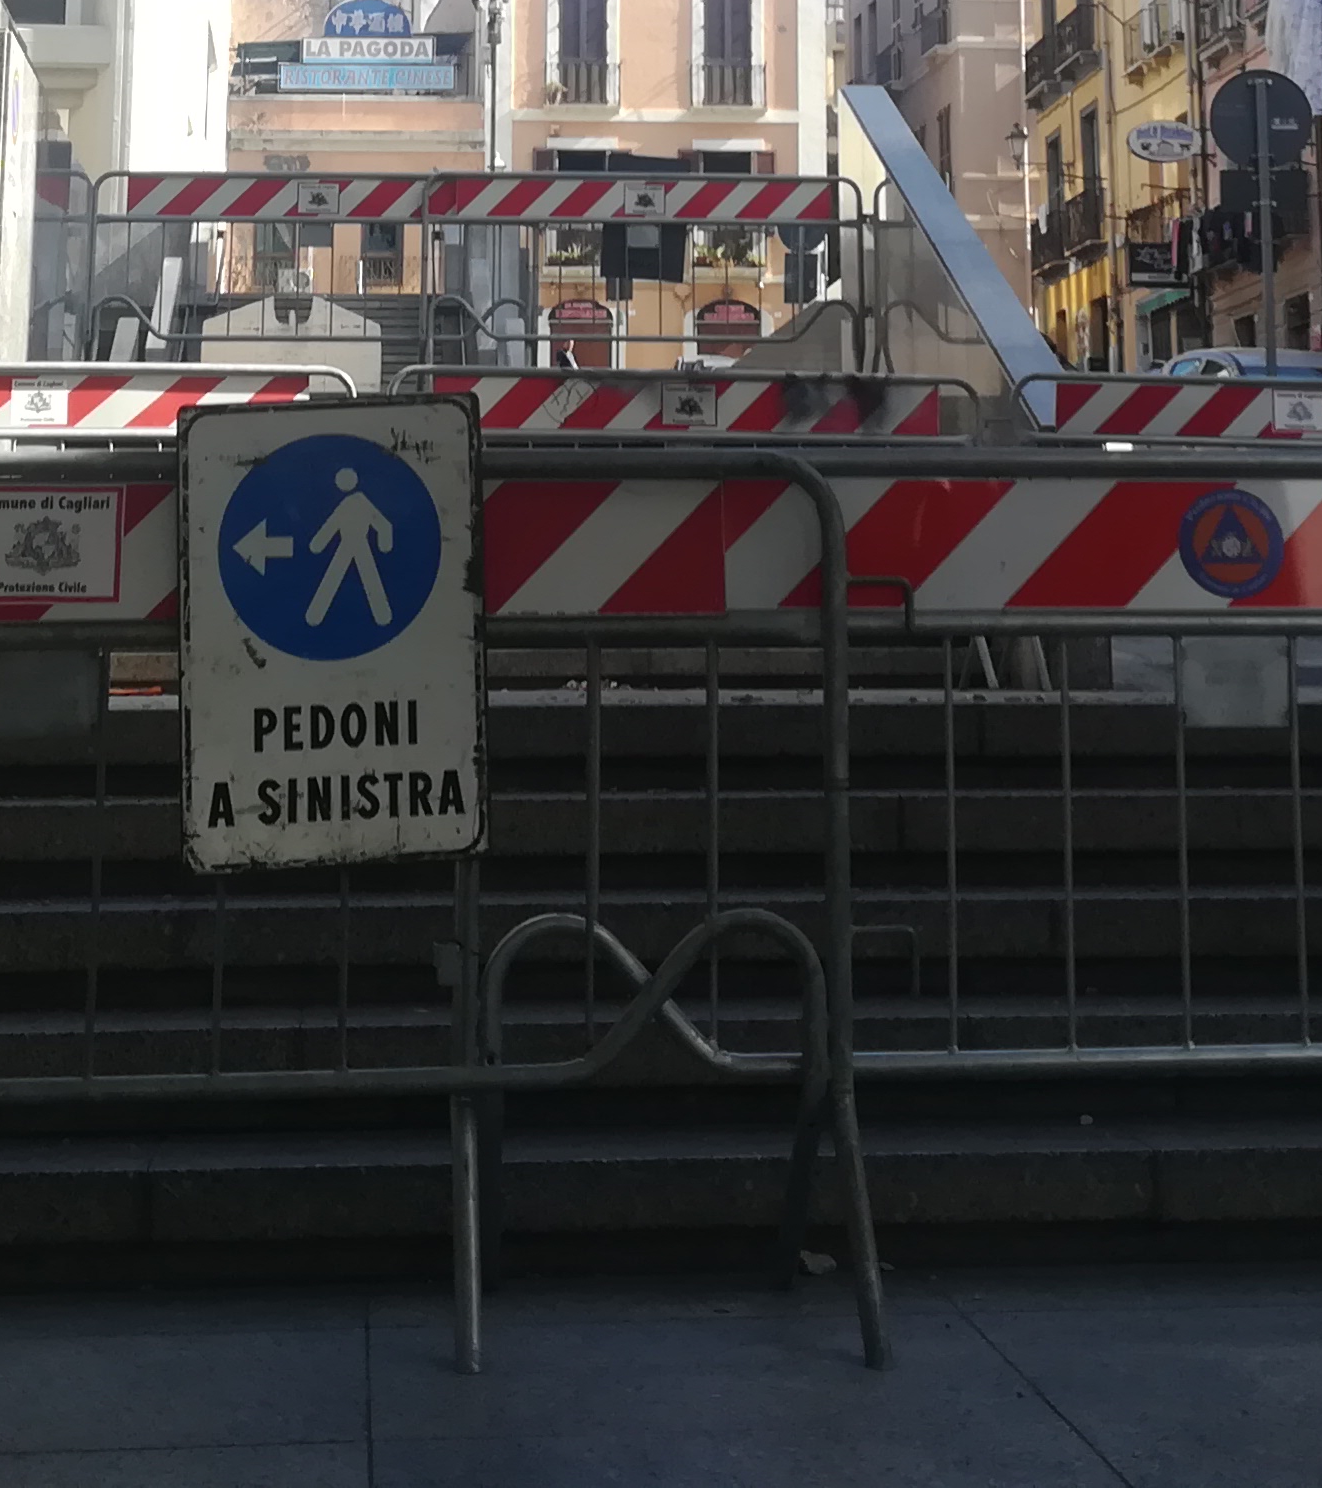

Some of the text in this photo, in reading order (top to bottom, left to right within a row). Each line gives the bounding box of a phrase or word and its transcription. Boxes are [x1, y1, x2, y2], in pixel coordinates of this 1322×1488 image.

[305, 40, 429, 57] LA PAGODA
[284, 68, 452, 86] RISTORANTE CINESE
[40, 496, 54, 510] di
[58, 496, 110, 513] Cagliari
[59, 582, 87, 593] Civile
[254, 700, 418, 752] PEDONI
[208, 769, 466, 828] A SINISTRA
